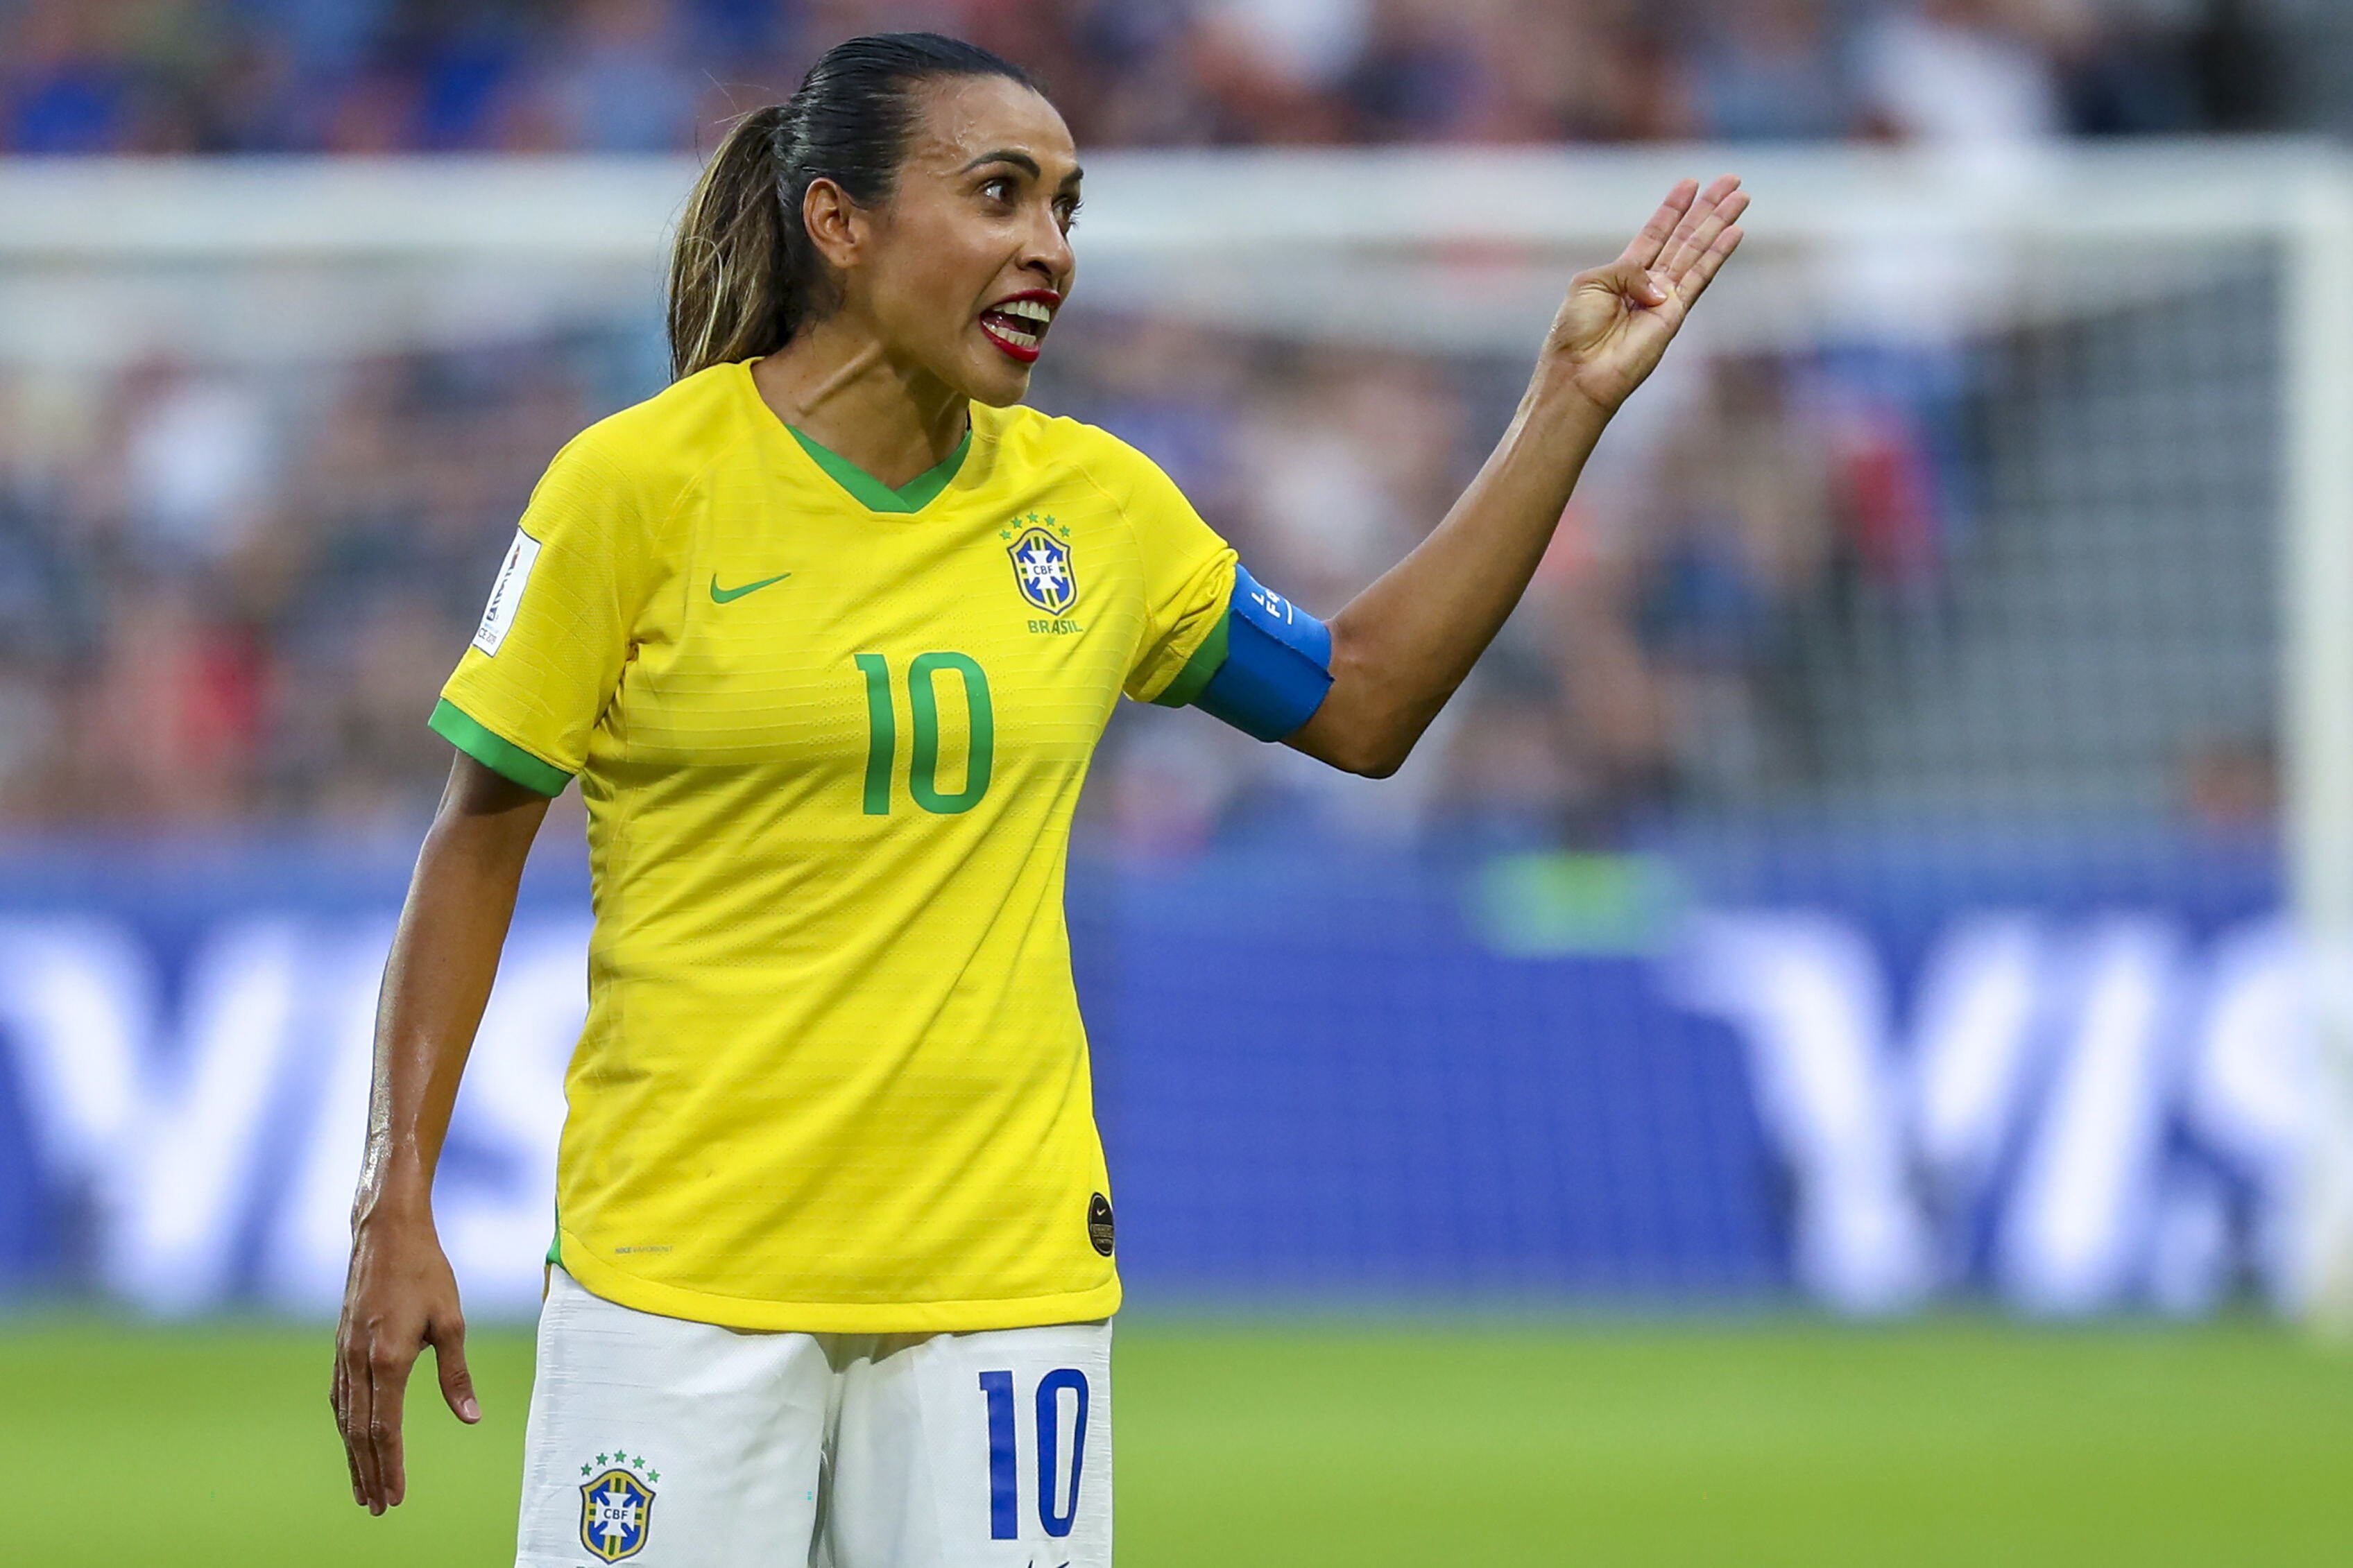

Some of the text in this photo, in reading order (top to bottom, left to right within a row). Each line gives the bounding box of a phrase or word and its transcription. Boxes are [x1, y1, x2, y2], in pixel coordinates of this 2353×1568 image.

[1033, 565, 1054, 576] CBF
[1027, 619, 1084, 635] BRASIL
[853, 651, 994, 816] 10
[979, 1368, 1089, 1540] 10
[604, 1508, 628, 1520] CBF
